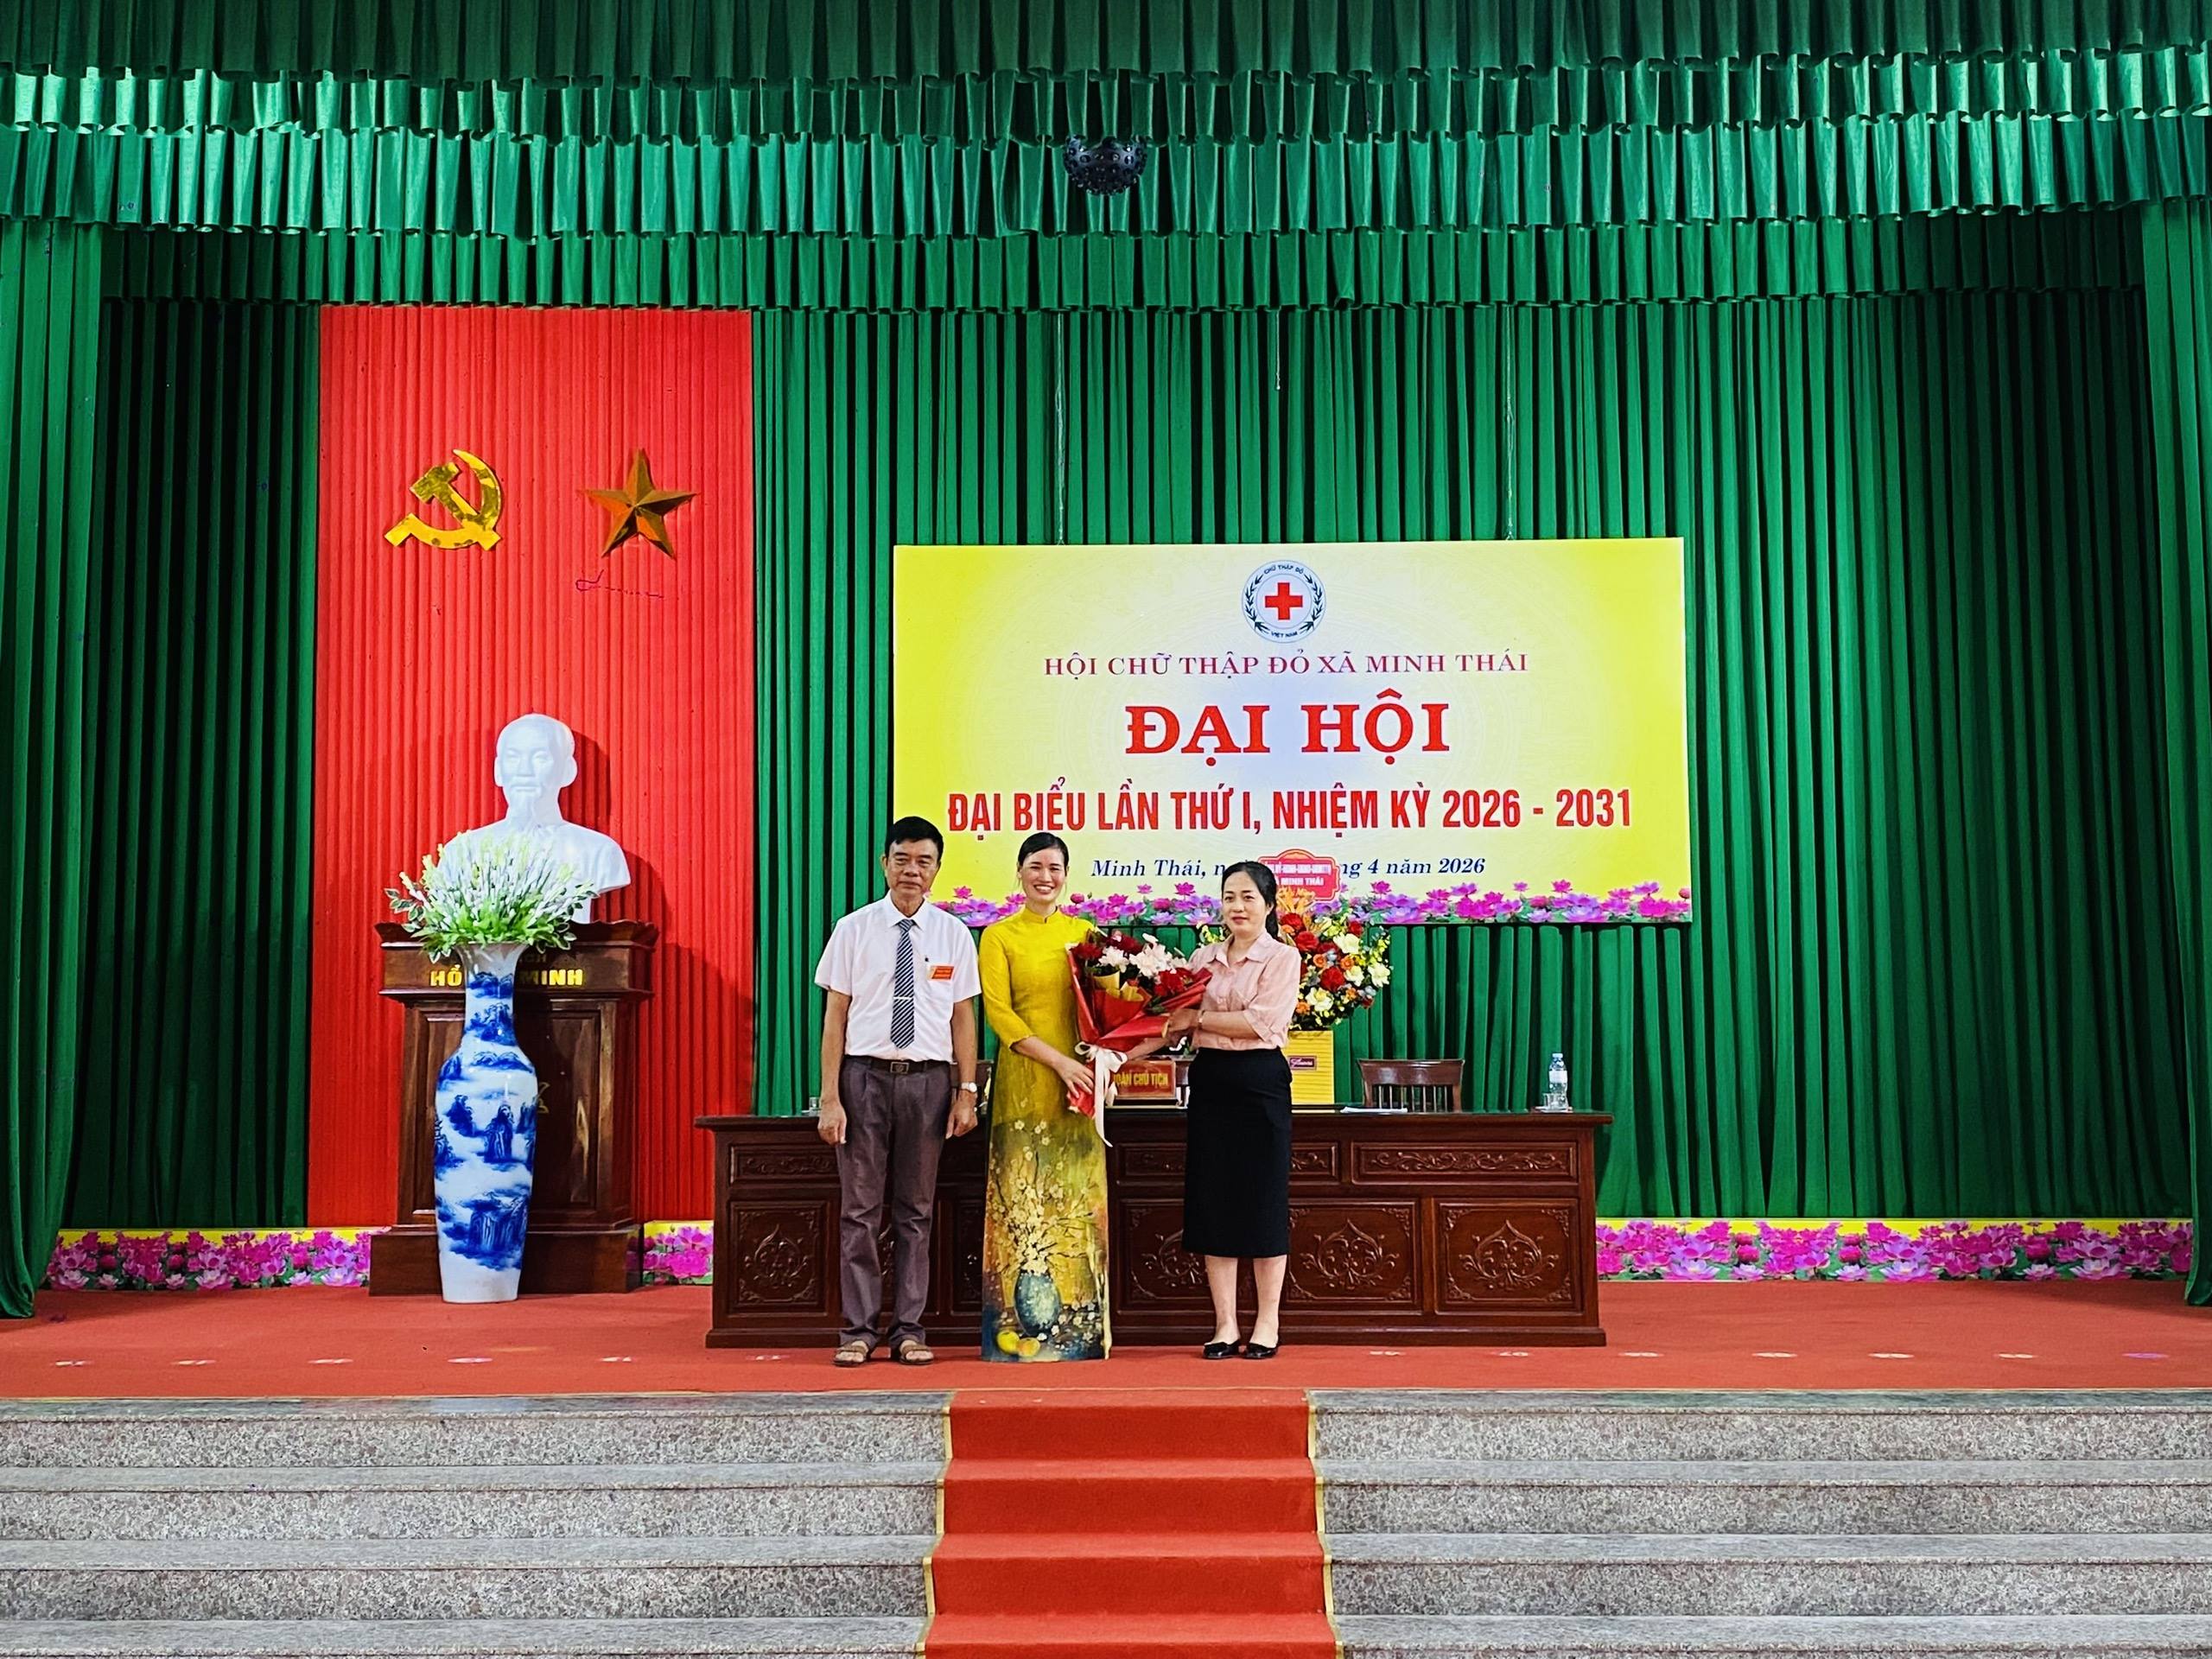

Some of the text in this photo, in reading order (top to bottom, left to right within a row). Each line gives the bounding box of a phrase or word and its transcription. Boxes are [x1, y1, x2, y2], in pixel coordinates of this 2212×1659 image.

[1044, 648, 1529, 680] HỘI CHỮ THẬP ĐỎ XÃ MINH THÁI
[1126, 688, 1449, 766] ĐẠI HỘI
[948, 792, 1001, 841] ĐẠI
[1014, 776, 1085, 831] BIỂU
[1097, 778, 1159, 830] LẦN
[1170, 783, 1234, 830] THỨ
[1243, 791, 1261, 835] I,
[1274, 782, 1378, 838] NHIỆM
[1391, 781, 1431, 828] KỲ
[1443, 789, 1521, 828] 2026
[1556, 789, 1630, 827] 2031
[1090, 859, 1146, 877] Minh
[1154, 859, 1206, 880] Thái,
[1368, 858, 1379, 874] 4
[1386, 859, 1432, 874] năm
[1438, 858, 1485, 874] 2026
